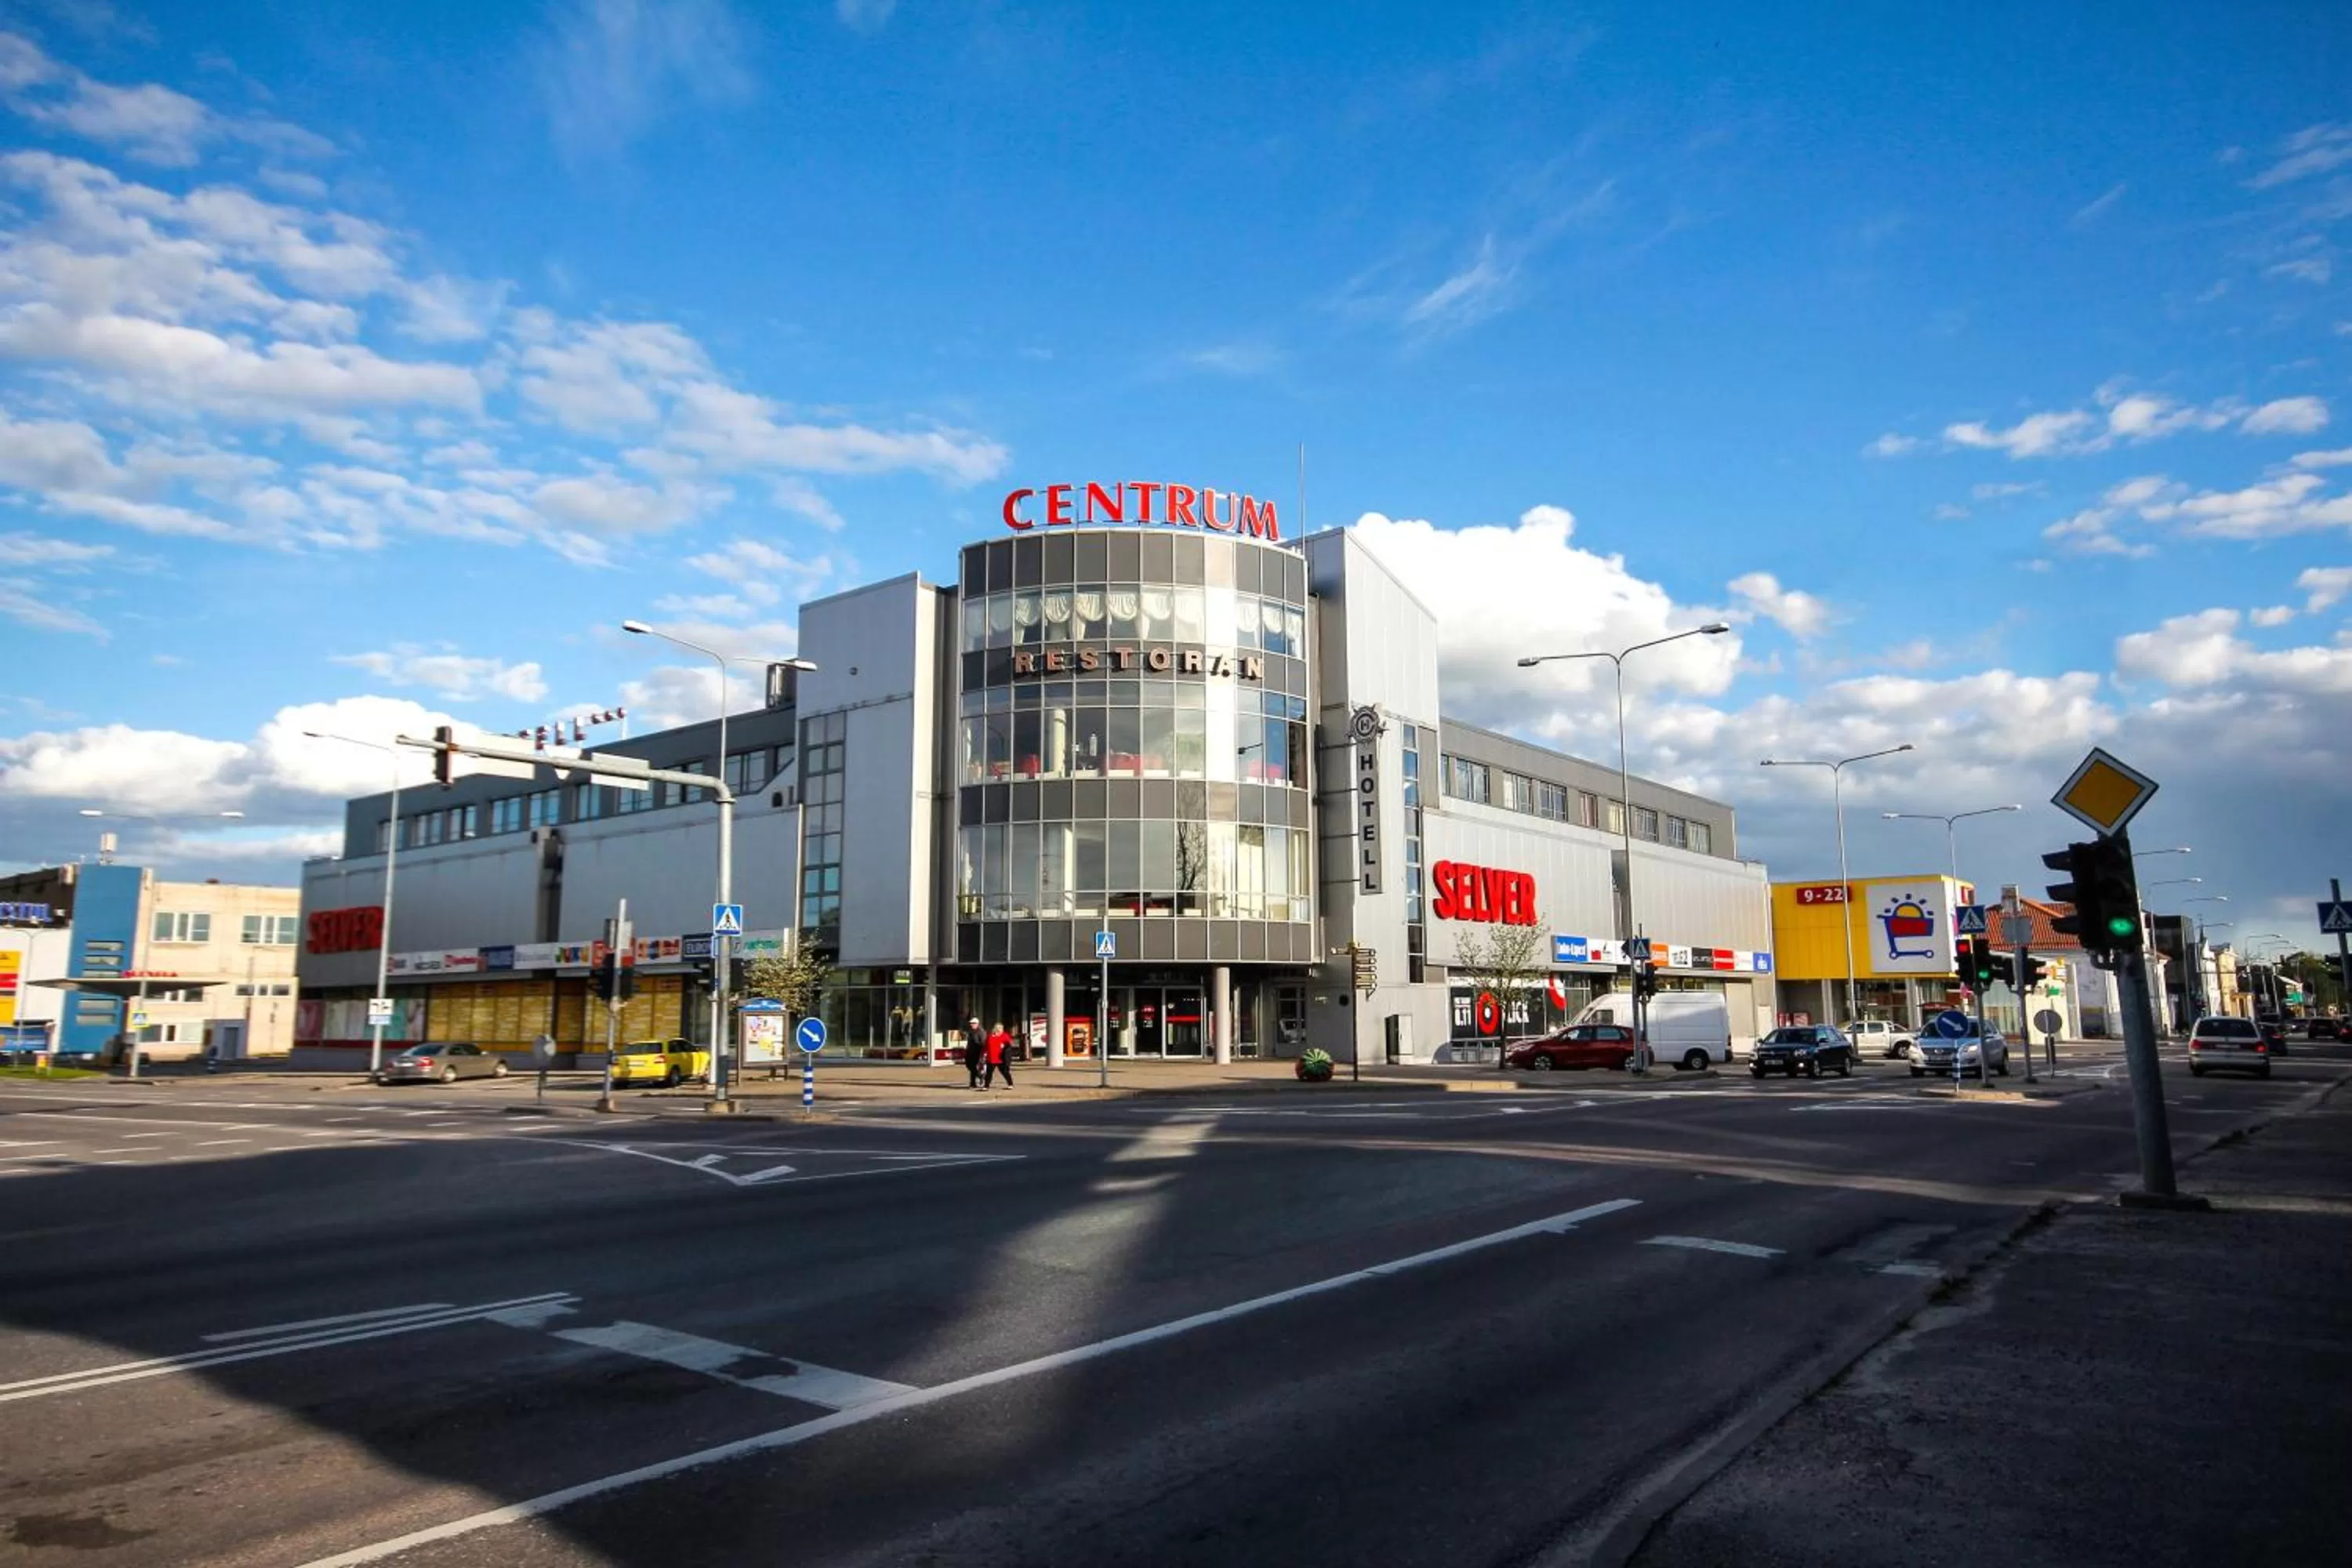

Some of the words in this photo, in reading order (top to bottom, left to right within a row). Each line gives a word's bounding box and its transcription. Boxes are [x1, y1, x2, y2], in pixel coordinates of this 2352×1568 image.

[1003, 481, 1280, 541] CENTRUM
[1014, 646, 1265, 681] RESTORAN
[1360, 753, 1376, 890] HOTELL
[1433, 860, 1537, 926] SELVER
[306, 906, 383, 954] SELVER
